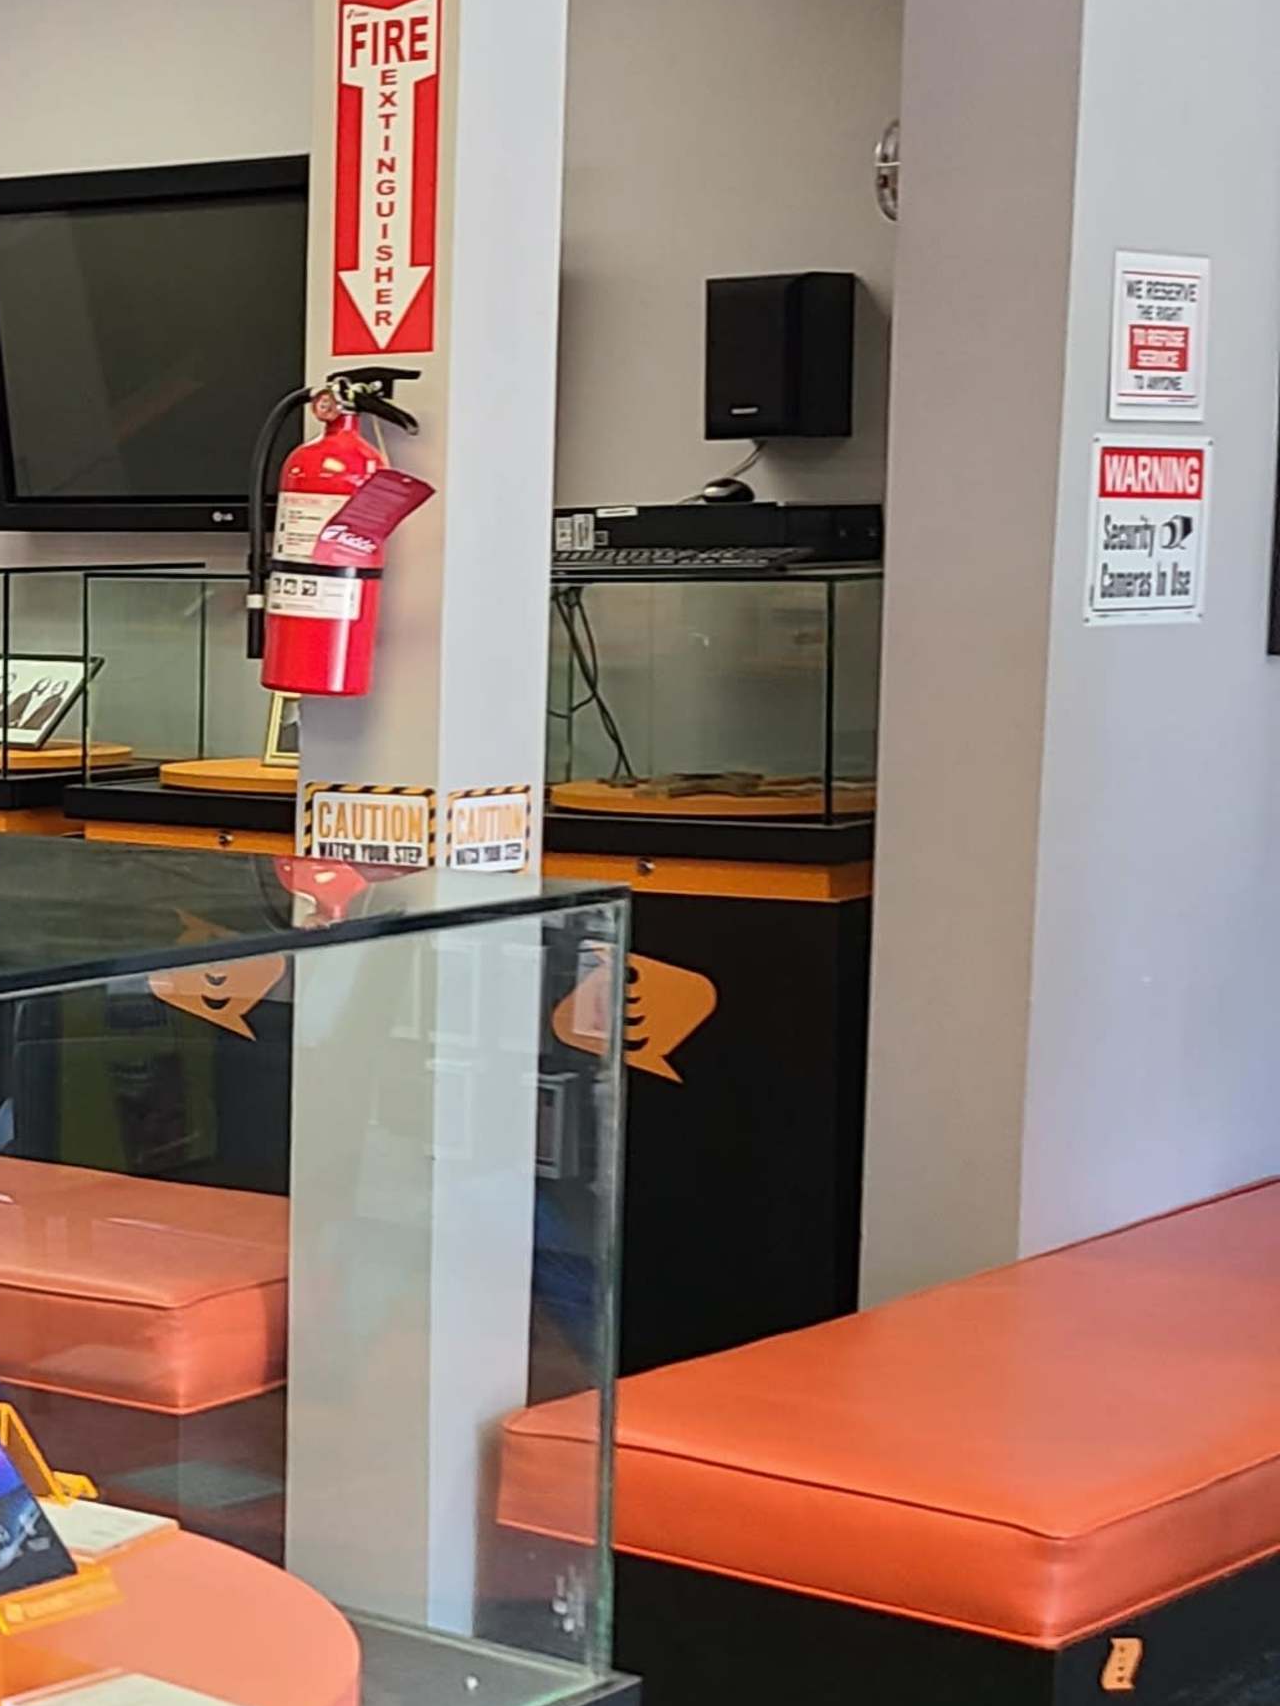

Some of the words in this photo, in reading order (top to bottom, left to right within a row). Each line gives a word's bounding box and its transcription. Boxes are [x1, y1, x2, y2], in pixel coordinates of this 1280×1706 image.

[349, 15, 430, 69] FIRE
[373, 68, 399, 328] EXTINGUISHER
[1126, 278, 1143, 299] WE
[1146, 280, 1198, 303] RESERVE
[1102, 453, 1201, 495] WARNING
[1102, 513, 1156, 558] Security
[1099, 561, 1153, 599] Cameras
[1170, 561, 1191, 597] Use
[317, 800, 425, 843] CAUTION
[455, 803, 524, 844] CAUTION
[317, 842, 357, 863] WATCH
[360, 844, 389, 864] YOUR
[393, 845, 424, 865] STEP
